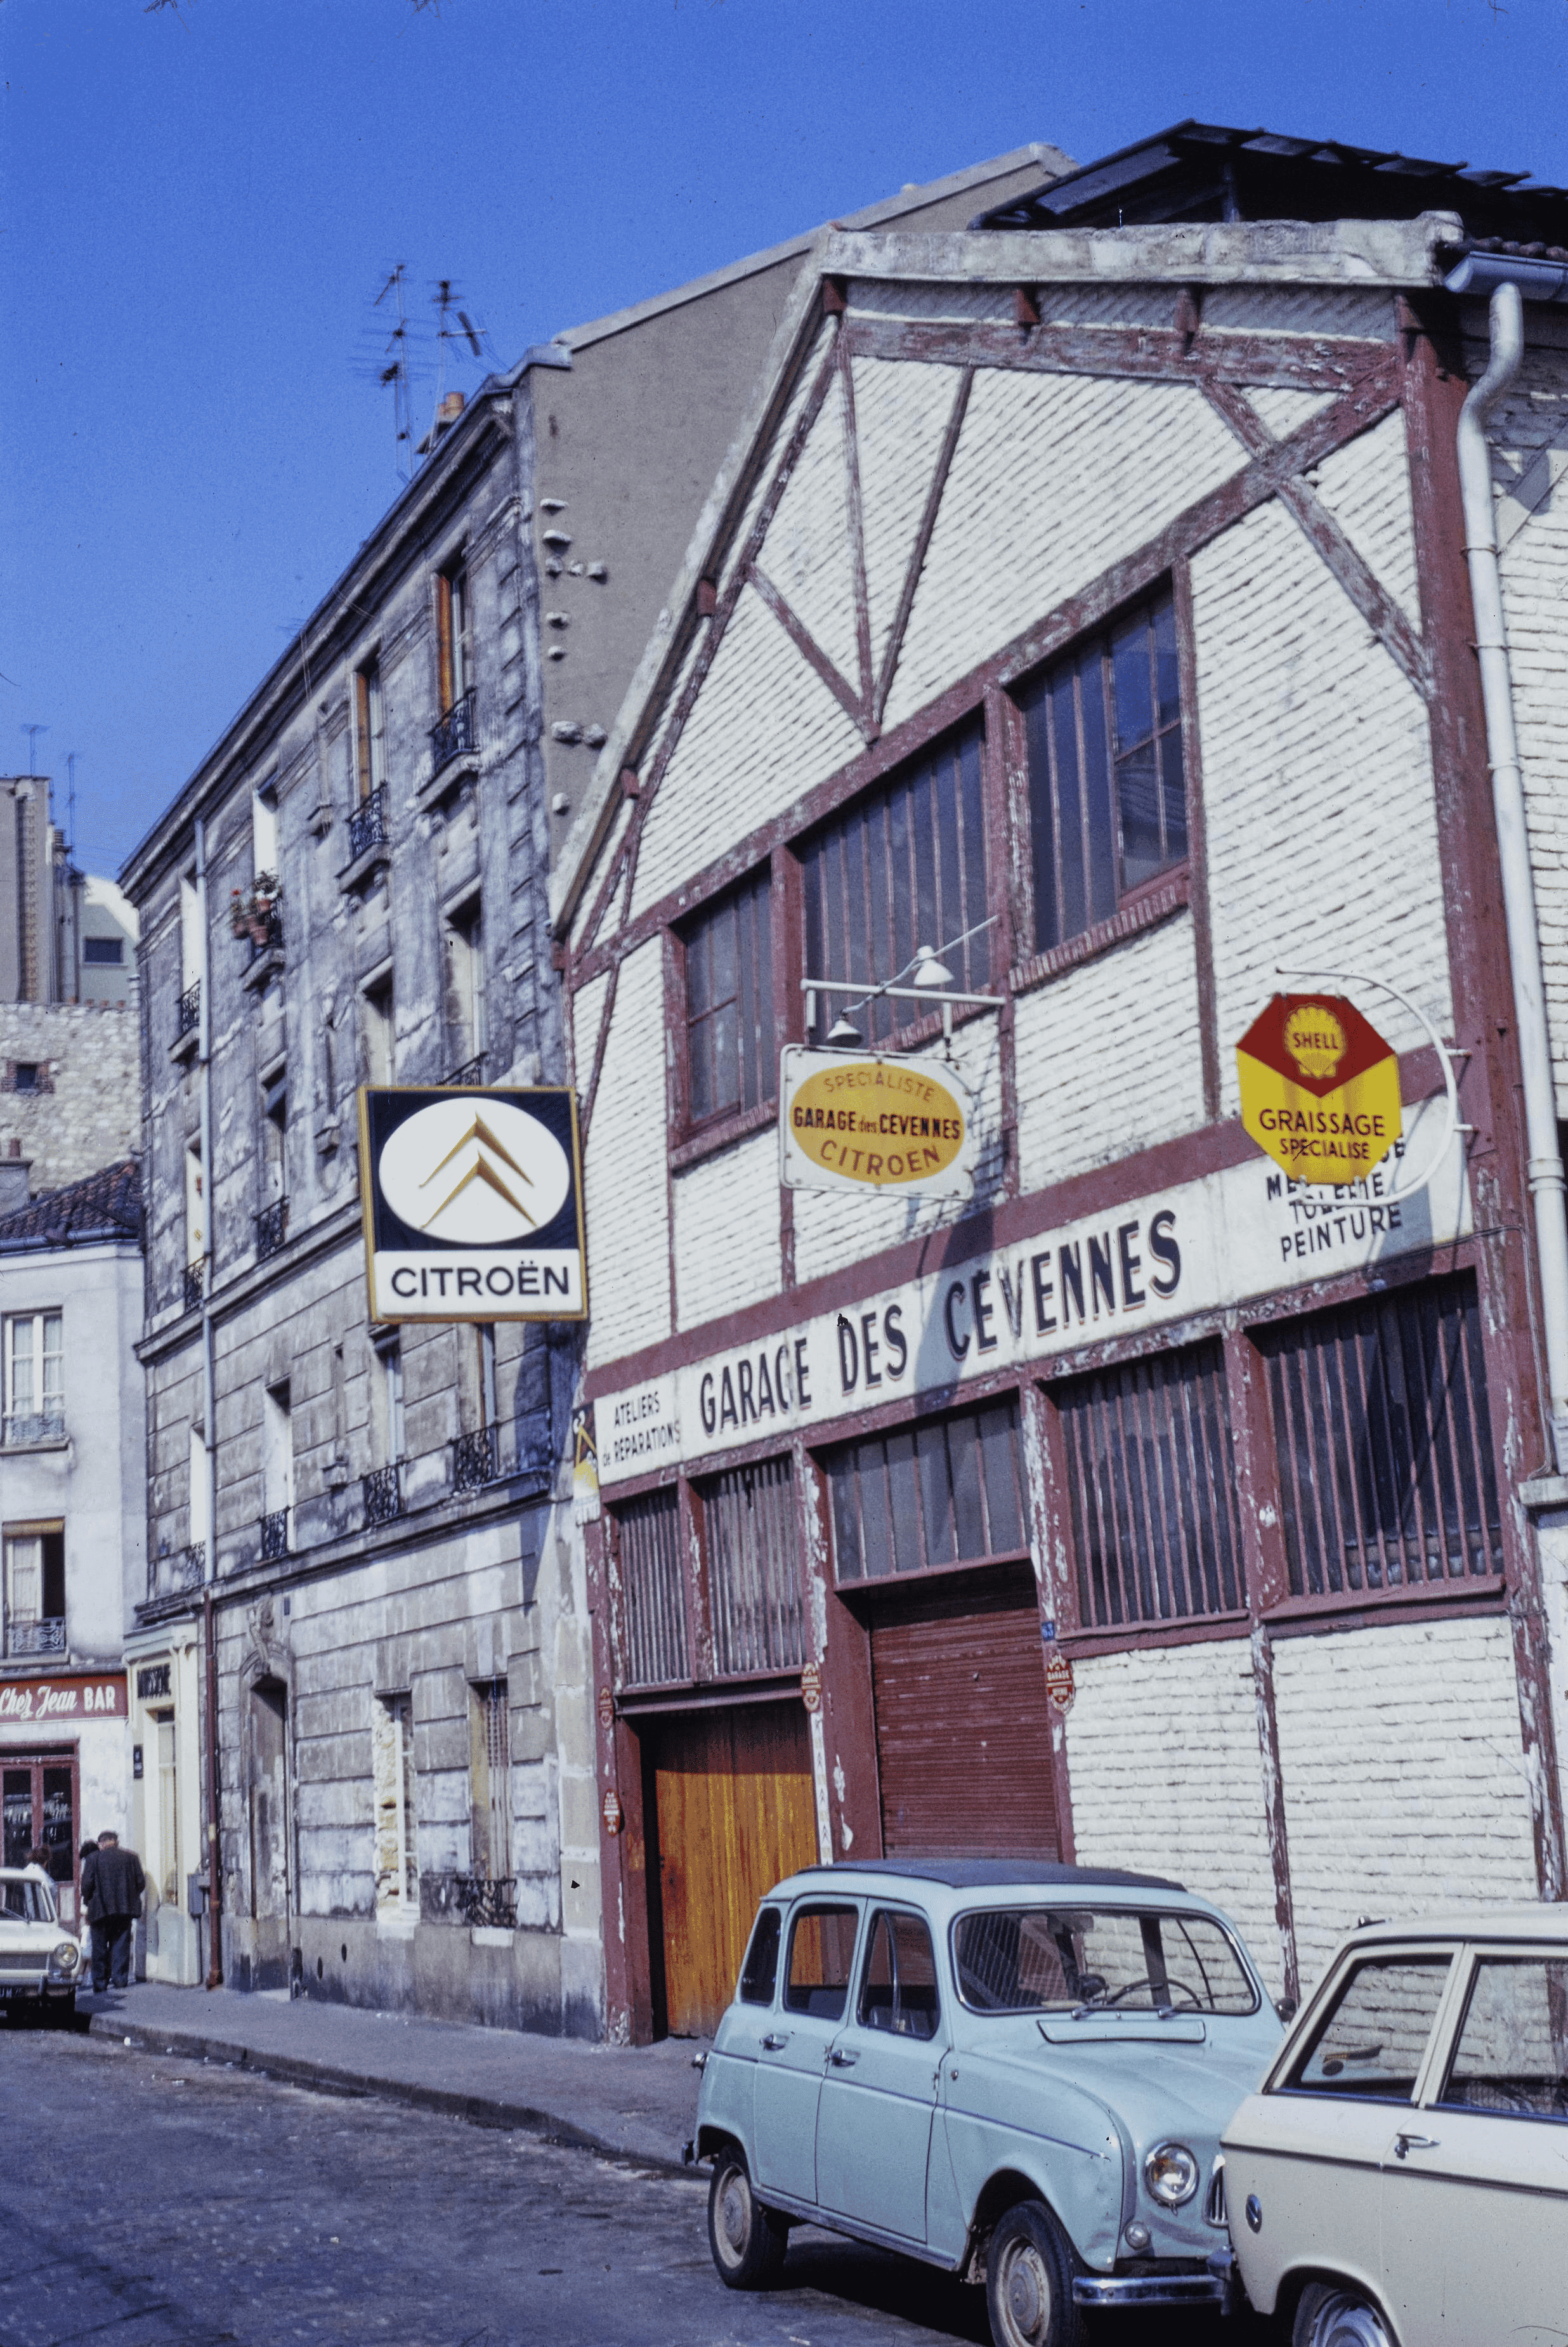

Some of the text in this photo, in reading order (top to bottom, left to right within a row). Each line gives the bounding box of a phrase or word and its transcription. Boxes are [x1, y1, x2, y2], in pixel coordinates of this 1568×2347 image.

[1293, 1032, 1338, 1049] SHELL
[824, 1070, 934, 1103] SPECIALISTE
[794, 1107, 960, 1140] GARAGE des CEVENNES
[1258, 1108, 1386, 1137] GRAISSAGE
[820, 1139, 941, 1176] CITROEN
[1279, 1137, 1370, 1160] SPECIALISE
[1281, 1202, 1402, 1262] PEINTURE
[391, 1260, 570, 1298] CITROËN
[700, 1337, 811, 1437] GARAGE
[837, 1304, 908, 1396] DES
[615, 1391, 661, 1427] ATELIERS
[0, 1685, 115, 1721] Chez Jean BAR
